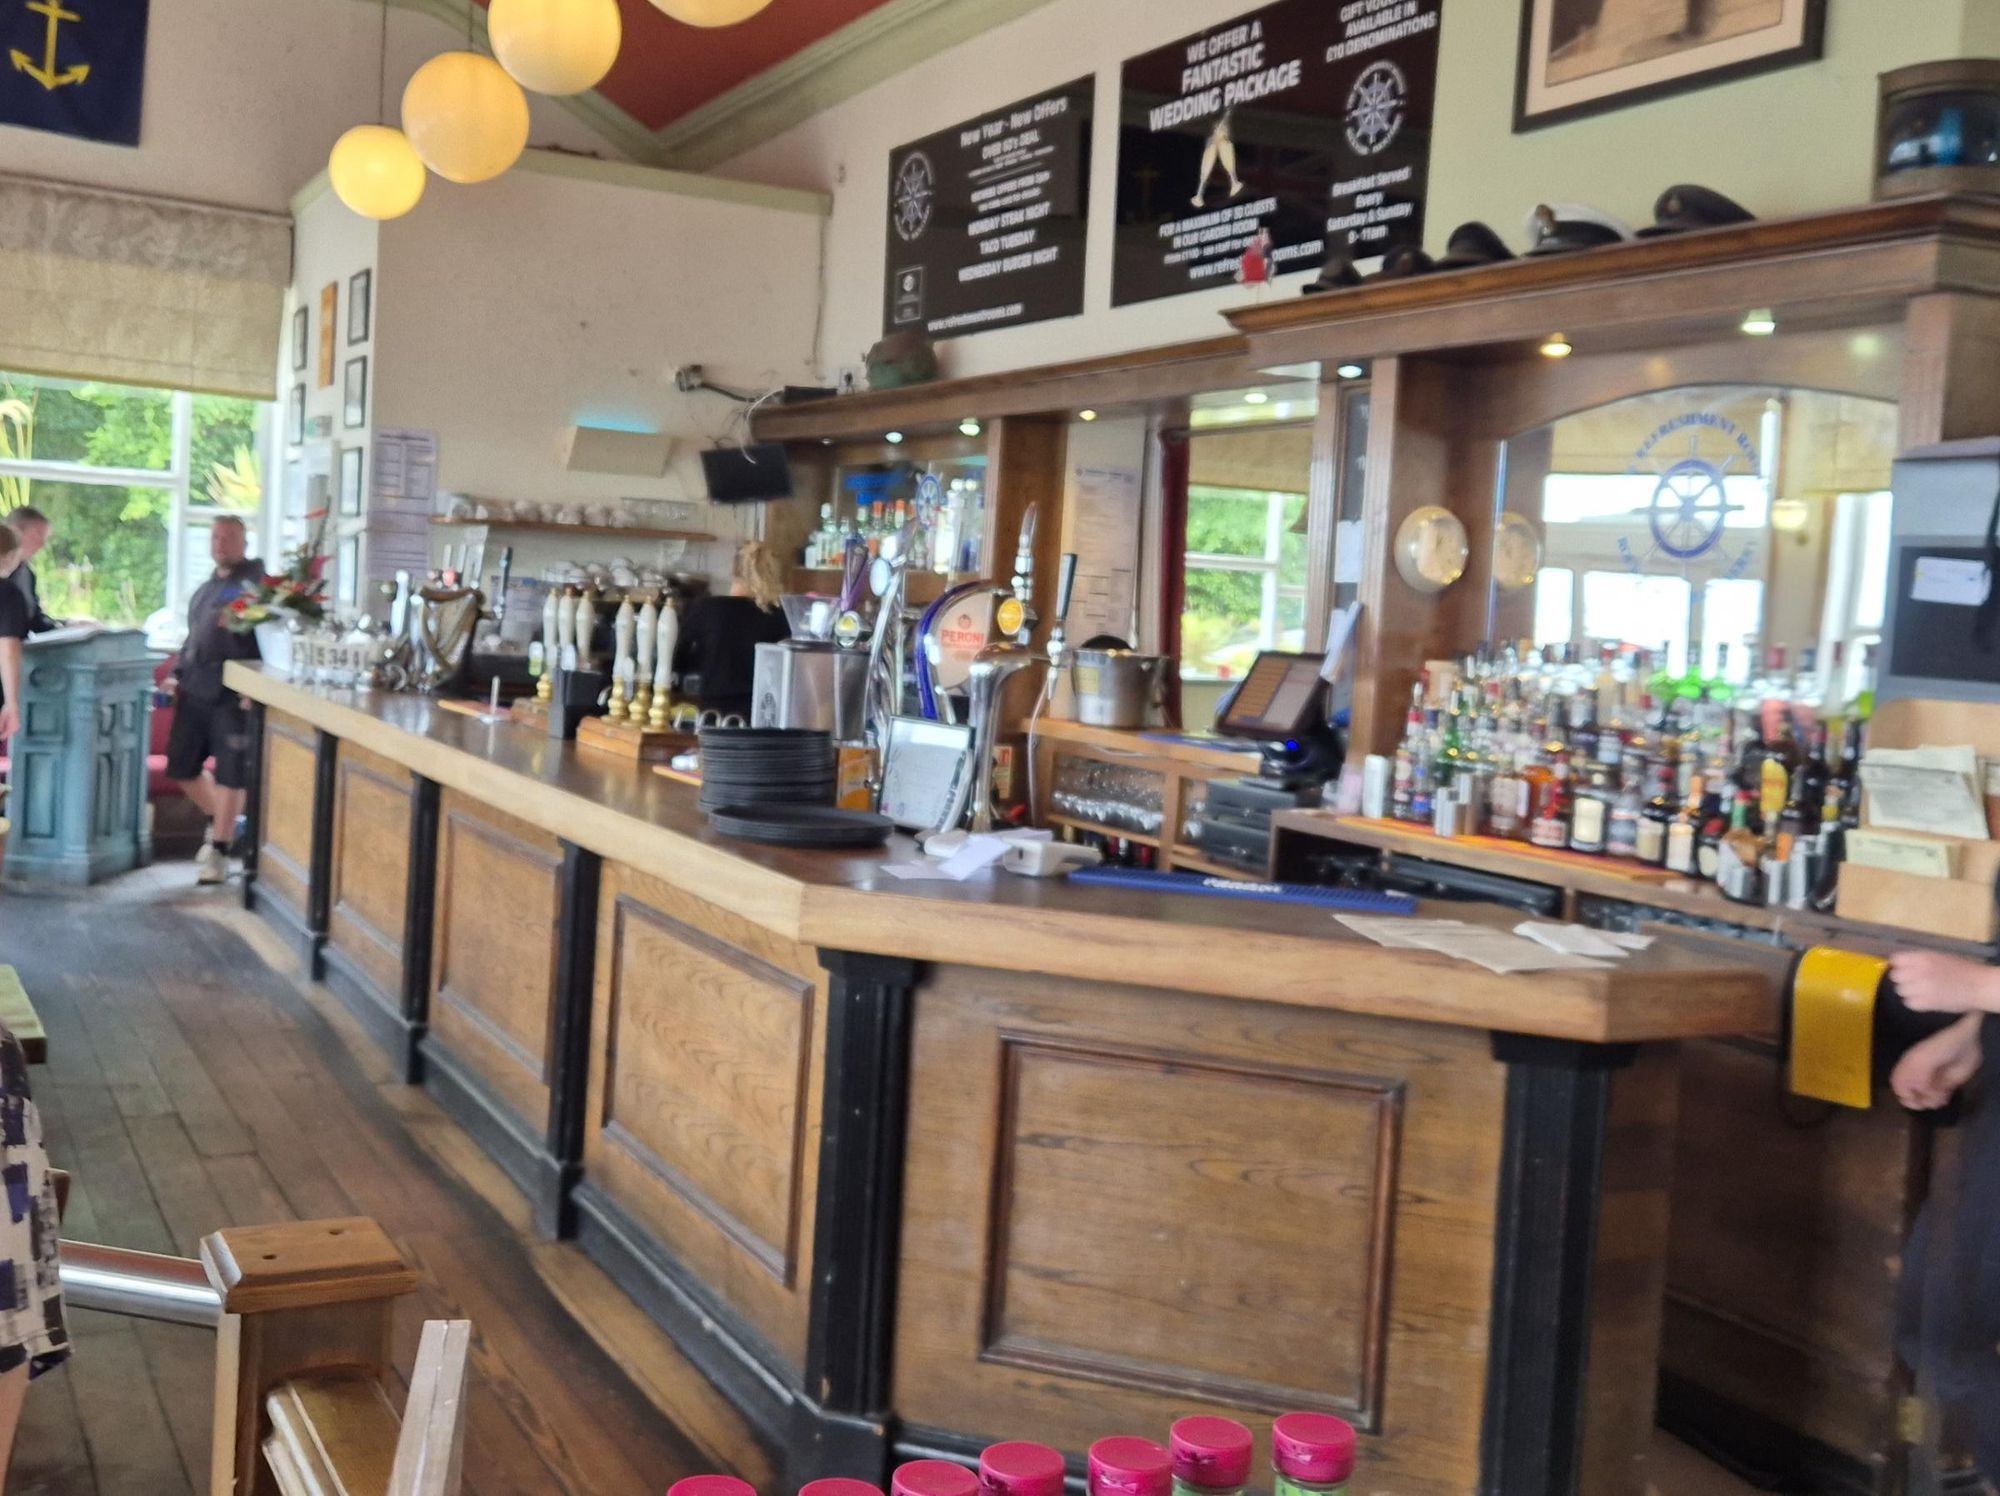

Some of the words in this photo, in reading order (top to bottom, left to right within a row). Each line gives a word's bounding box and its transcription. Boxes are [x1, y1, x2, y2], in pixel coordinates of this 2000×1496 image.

[1340, 1, 1365, 23] GIFT
[1345, 5, 1402, 38] AVAILABLE
[1403, 1, 1418, 17] IN
[1187, 39, 1207, 64] WE
[1208, 23, 1249, 56] OFFER
[1251, 19, 1262, 41] A
[1344, 10, 1438, 57] DENOMINATIONS
[1181, 41, 1266, 95] FANTASTIC
[1149, 86, 1223, 132] WEDDING
[1224, 58, 1302, 107] PACKAGE
[1010, 109, 1032, 130] New
[1033, 96, 1068, 122] Offers
[1331, 173, 1375, 197] Breakfast
[1375, 165, 1412, 187] Served
[1000, 207, 1025, 228] STEAK
[1025, 200, 1051, 221] NIGHT
[1355, 191, 1385, 209] Every
[1159, 223, 1176, 239] FOR
[1181, 210, 1220, 234] MAXIMUM
[1244, 197, 1278, 217] GUESTS
[1182, 230, 1199, 246] OUR
[1199, 223, 1232, 243] GARDEN
[1232, 217, 1259, 237] ROOM
[1326, 211, 1367, 232] Saturday
[1375, 201, 1415, 221] Sunday
[999, 228, 1036, 250] TUESDAY
[1033, 245, 1059, 265] NIGHT
[940, 629, 985, 643] PERONI
